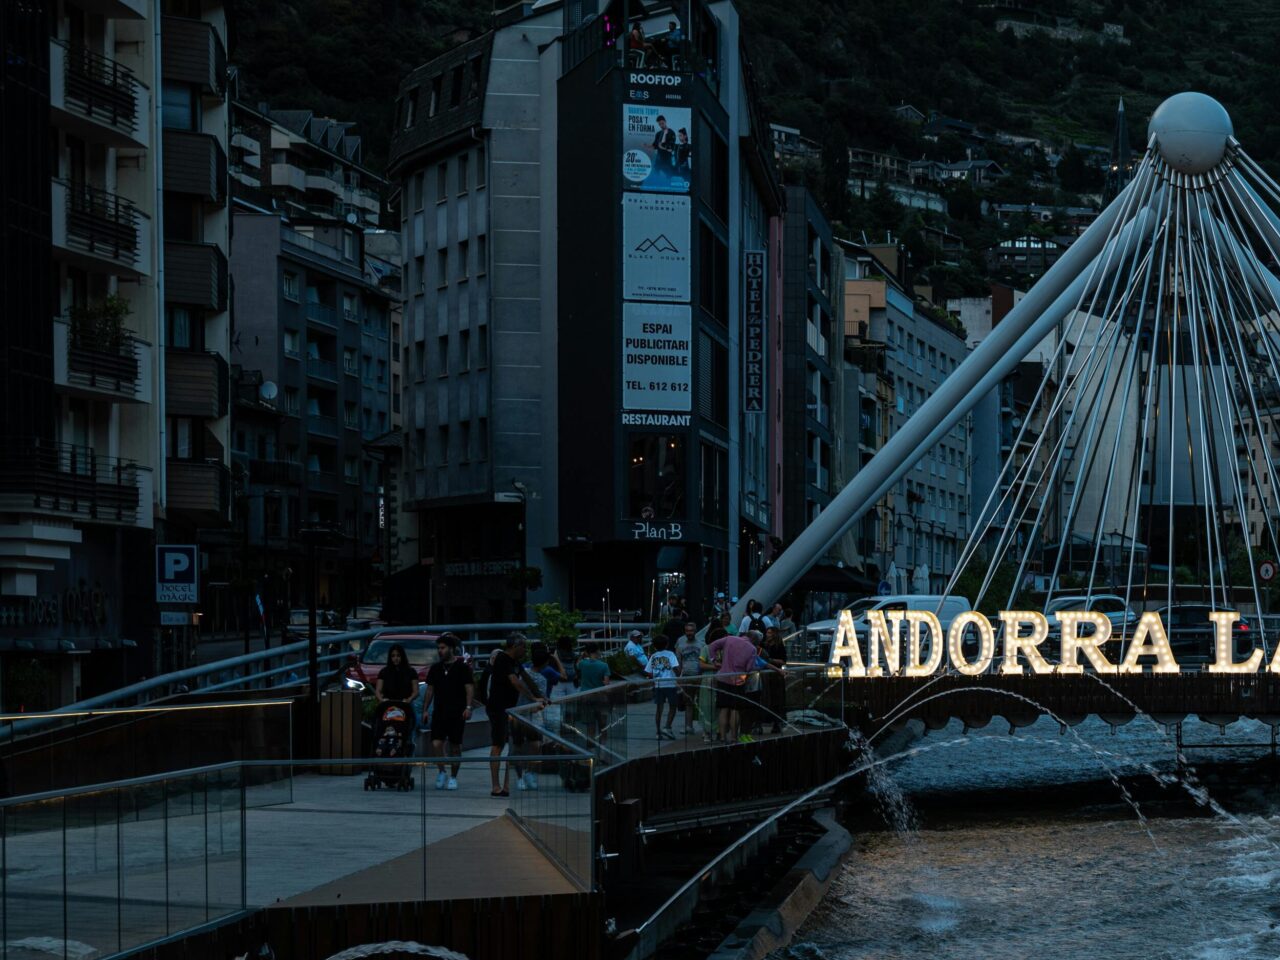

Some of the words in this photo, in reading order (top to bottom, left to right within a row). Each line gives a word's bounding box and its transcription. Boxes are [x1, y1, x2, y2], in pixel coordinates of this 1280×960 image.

[629, 73, 682, 86] ROOFTOP
[628, 123, 636, 132] EN
[636, 124, 655, 132] FORMA
[642, 323, 672, 334] ESPAI
[625, 338, 689, 350] PUBLICITARI
[626, 354, 688, 366] DISPONIBLE
[625, 381, 646, 390] TEL.
[649, 381, 667, 391] 612
[670, 382, 689, 392] 612
[622, 413, 692, 427] RESTAURANT
[632, 521, 666, 540] Plan
[667, 523, 682, 540] B
[164, 552, 190, 580] P
[828, 609, 1182, 677] ANDORRA
